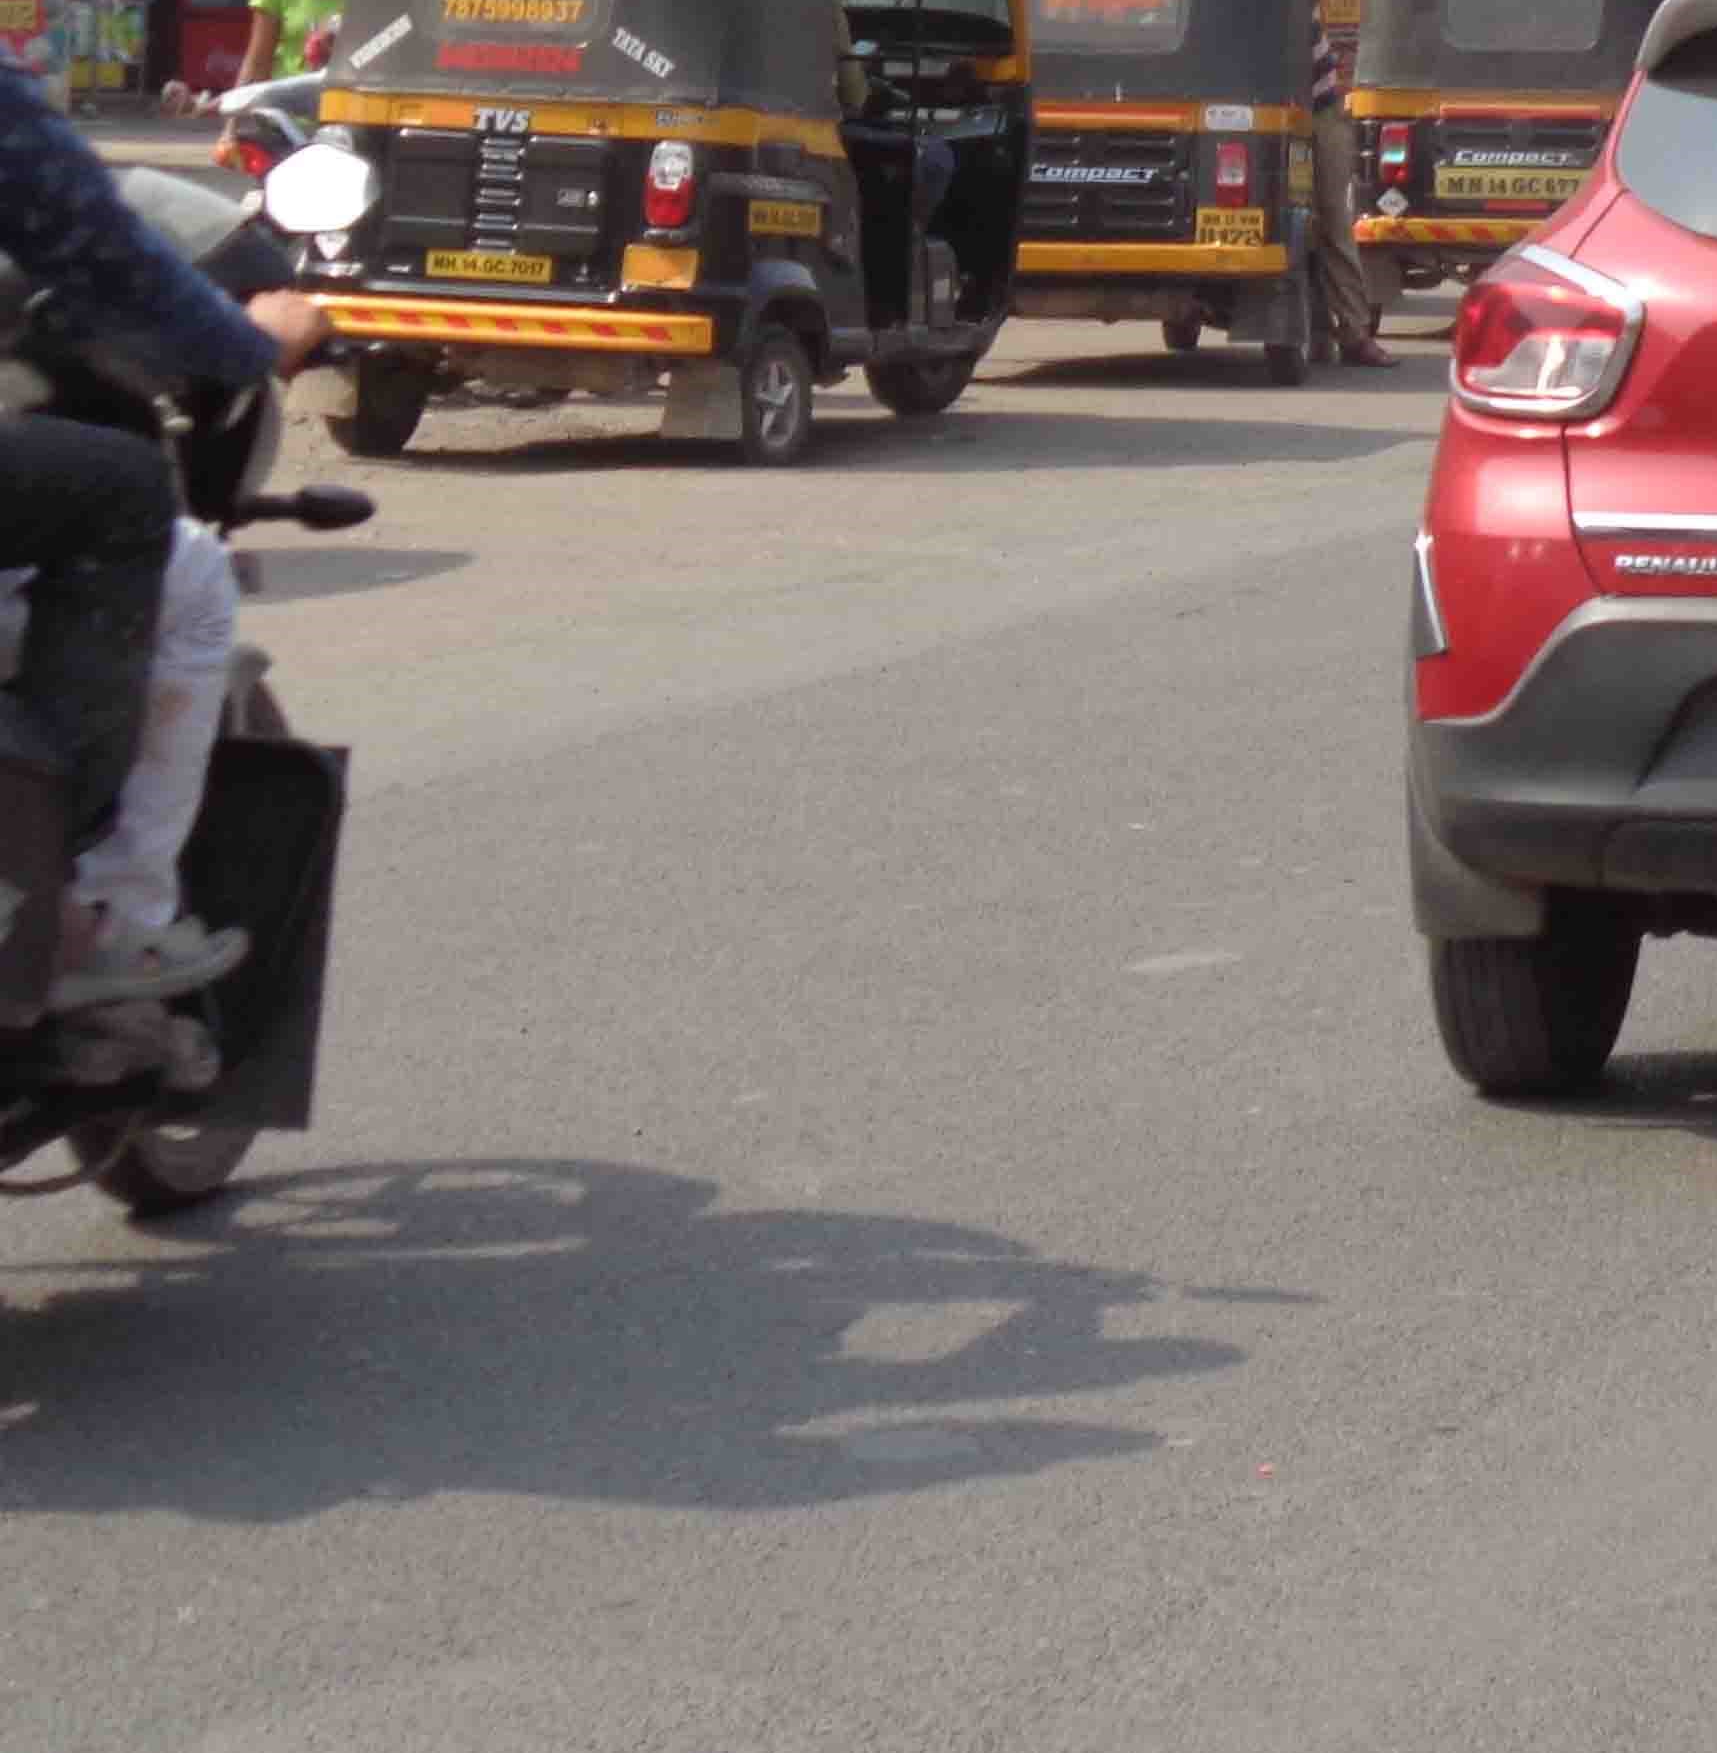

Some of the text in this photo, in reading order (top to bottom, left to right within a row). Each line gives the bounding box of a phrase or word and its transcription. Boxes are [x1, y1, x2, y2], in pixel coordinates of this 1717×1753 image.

[611, 27, 647, 63] TATA
[643, 49, 677, 78] SKY
[473, 108, 532, 134] TVS
[1454, 149, 1572, 168] Compact
[1029, 163, 1160, 184] Compact
[1447, 177, 1481, 195] MH
[1489, 177, 1508, 196] 14
